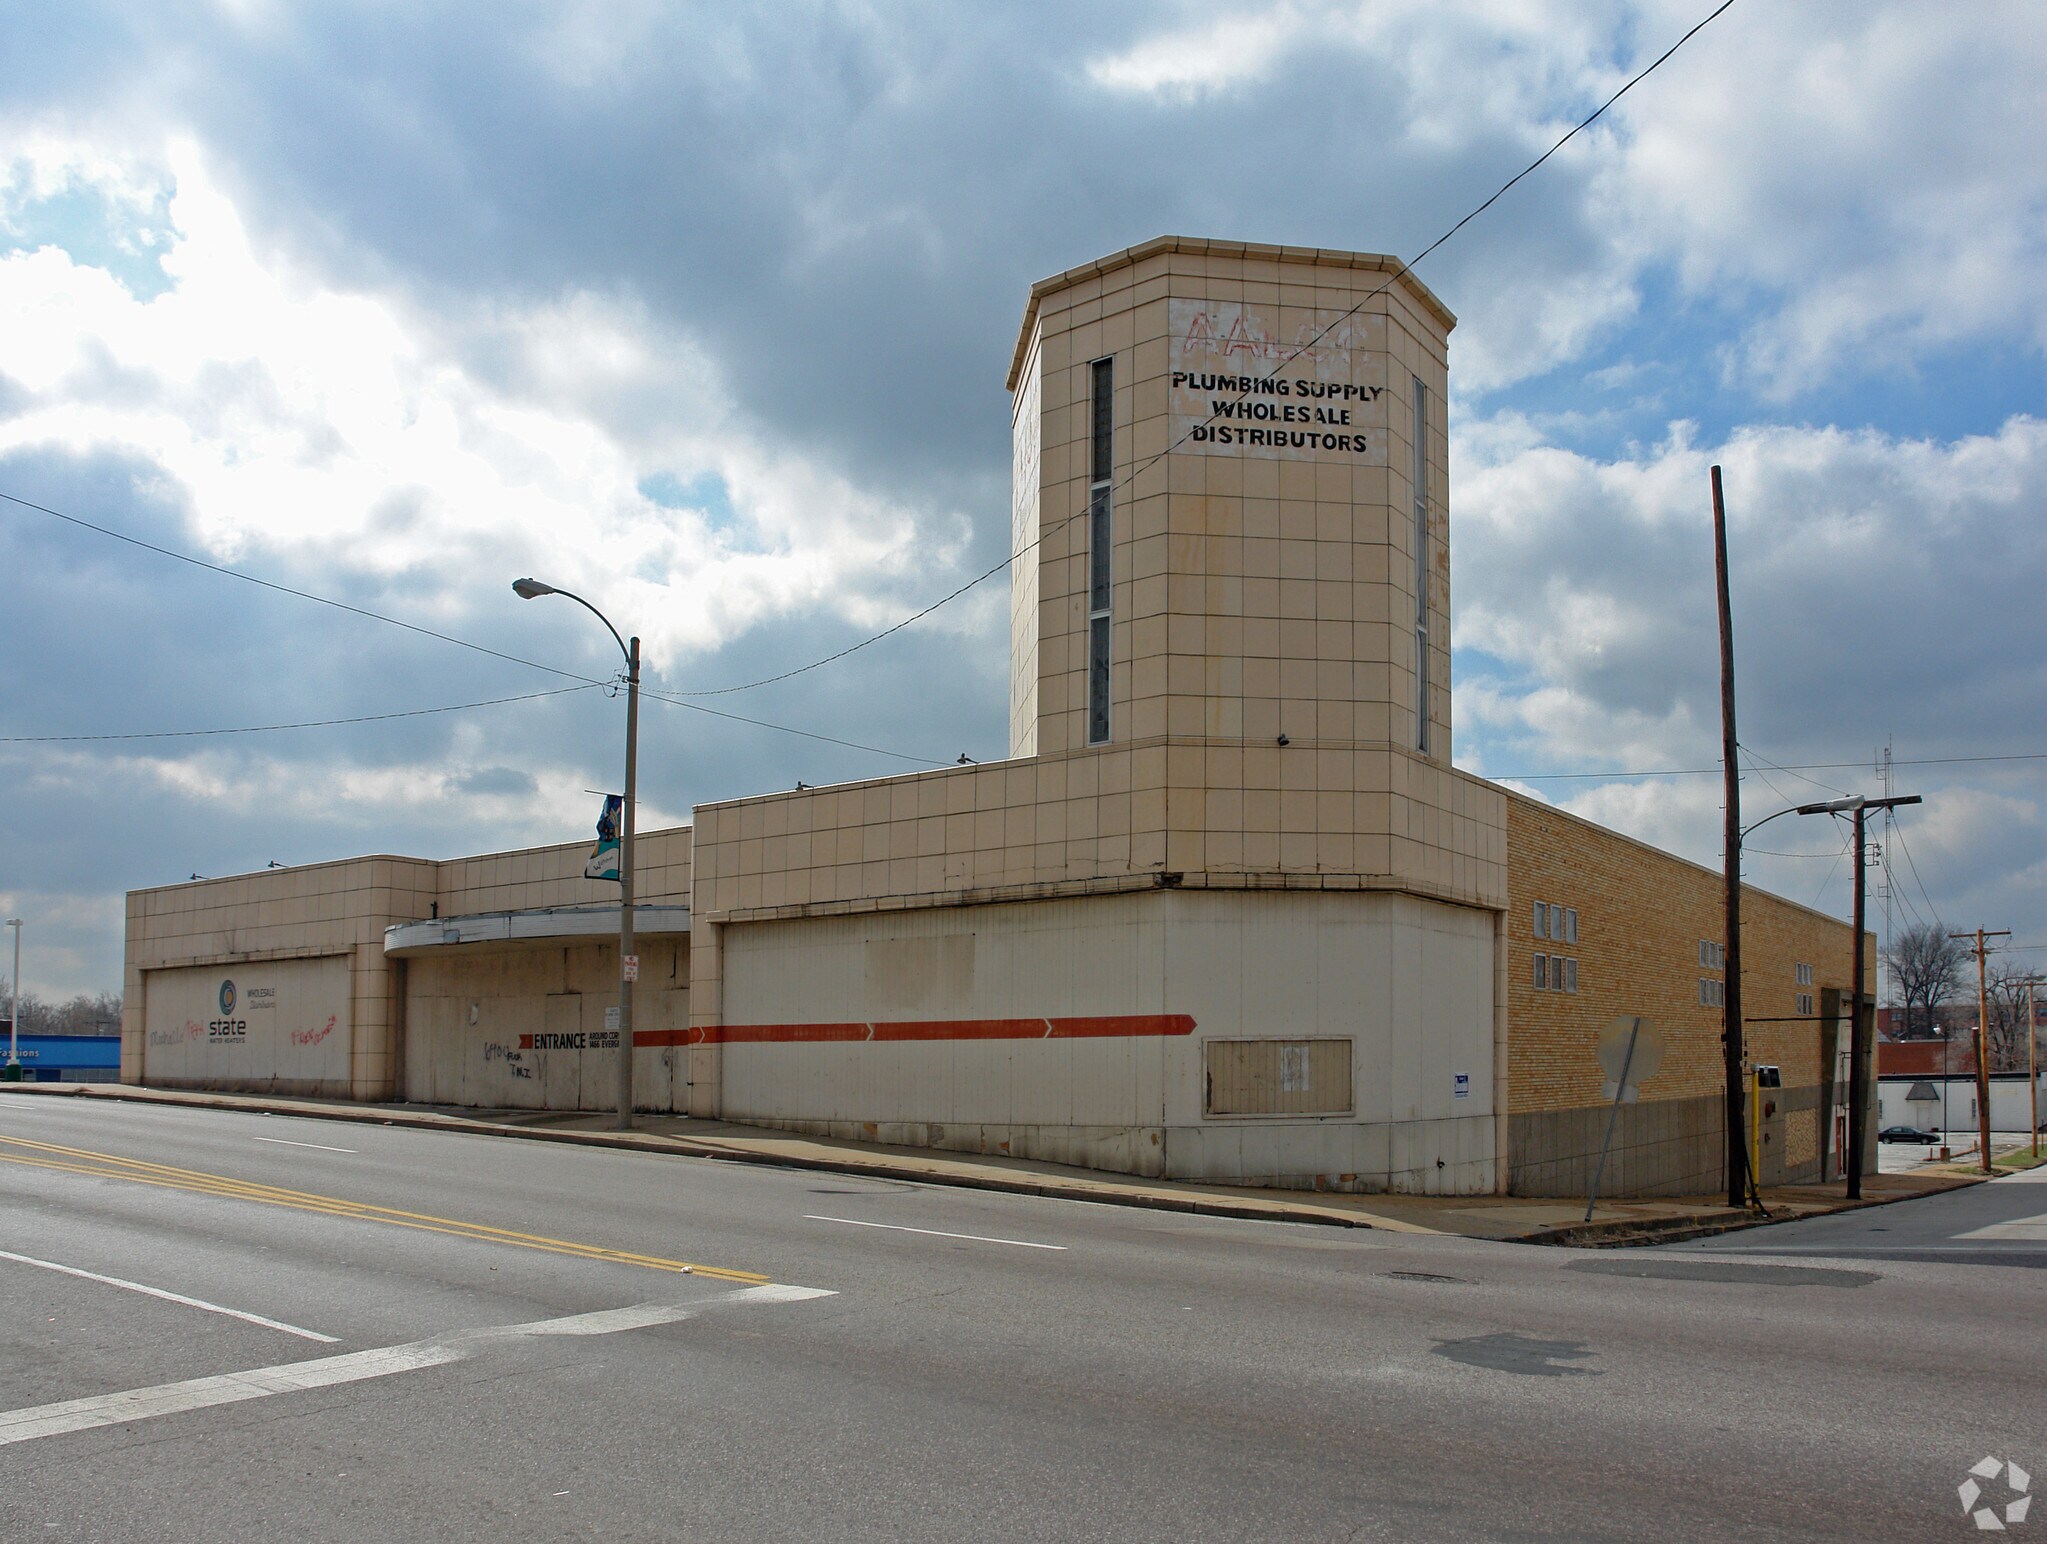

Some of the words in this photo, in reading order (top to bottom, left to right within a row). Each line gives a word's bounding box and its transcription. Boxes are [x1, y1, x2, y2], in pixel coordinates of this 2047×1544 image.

[1172, 371, 1290, 396] PLUMBING
[1295, 379, 1384, 402] SUPPLY
[1211, 400, 1352, 426] WHOLESALE
[1192, 424, 1367, 453] DISTRIBUTORS
[209, 1018, 246, 1036] state
[589, 1032, 608, 1040] AROUND
[609, 1031, 619, 1039] COR
[534, 1032, 586, 1050] ENTRANCE
[601, 1040, 619, 1048] EVERG
[0, 1048, 39, 1057] asions
